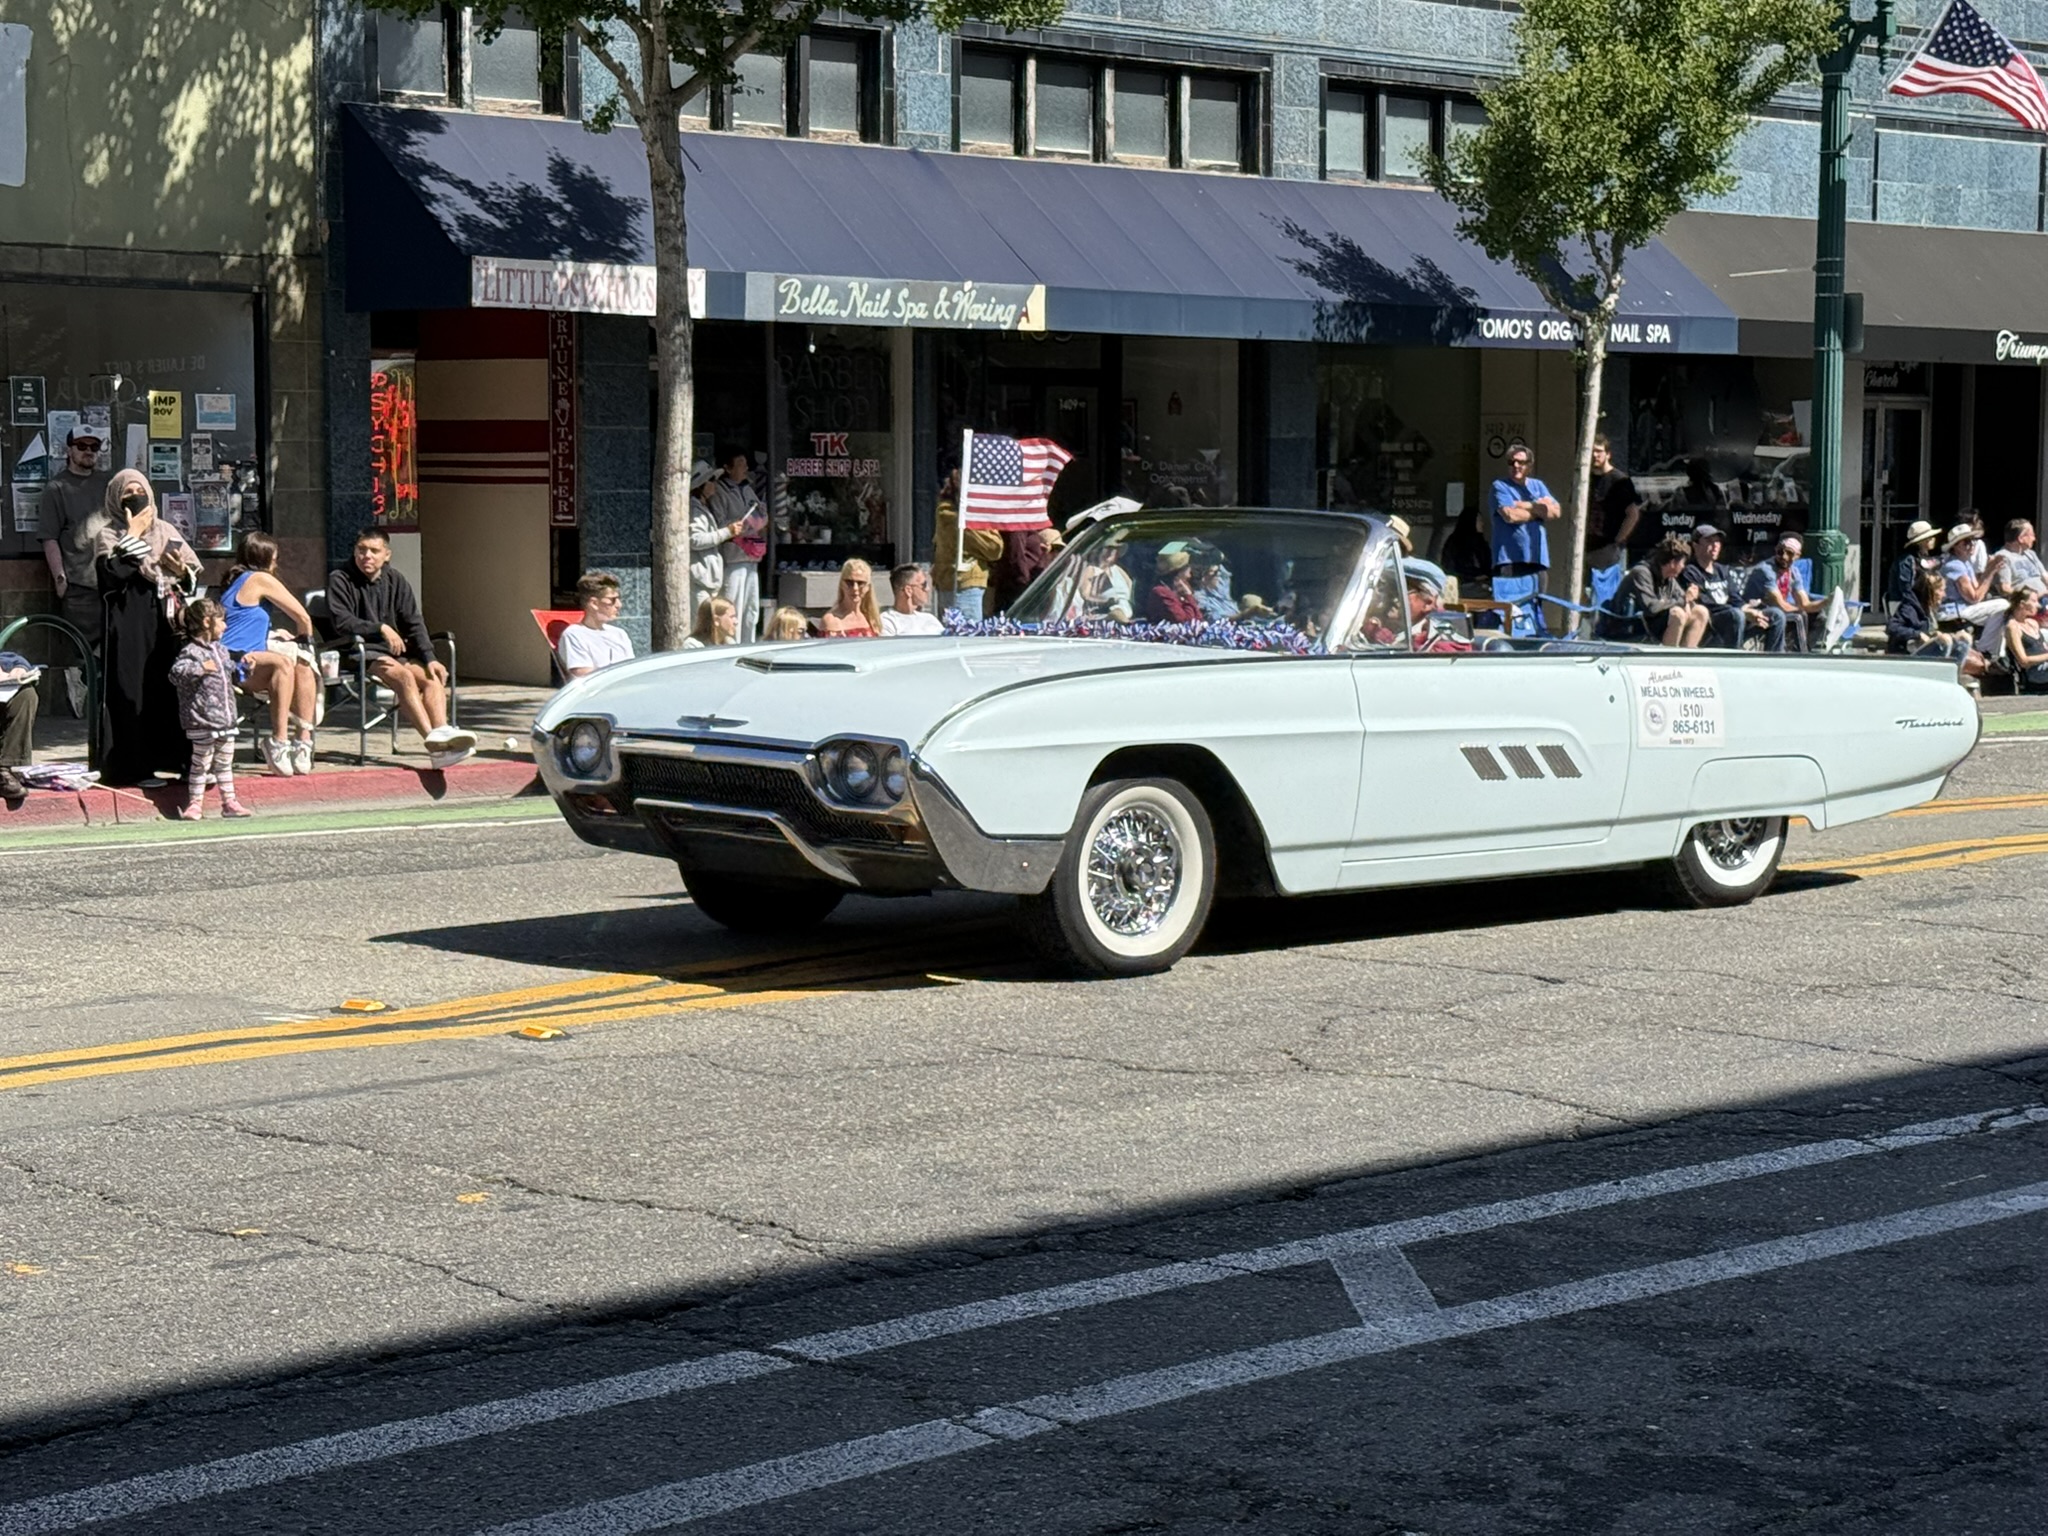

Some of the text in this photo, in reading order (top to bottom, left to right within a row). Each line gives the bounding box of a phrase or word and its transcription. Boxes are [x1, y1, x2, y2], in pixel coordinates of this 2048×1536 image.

[482, 264, 553, 306] LITTLE
[778, 278, 1017, 329] Bella Nail Spa & Waxing
[1477, 317, 1533, 340] TOMO'S
[1611, 323, 1641, 343] NAIL
[1646, 324, 1671, 344] SPA
[153, 395, 176, 406] IMP
[153, 407, 174, 416] ROV
[810, 432, 850, 457] TK
[787, 458, 825, 477] BARBER
[826, 459, 851, 478] SHOP
[863, 460, 881, 478] SPA
[1662, 511, 1696, 528] Sunday
[1732, 511, 1782, 527] Wednesday
[1640, 686, 1715, 699] MEALS ON WHEELS
[1679, 703, 1703, 718] (510)
[1672, 719, 1715, 734] 865-6131
